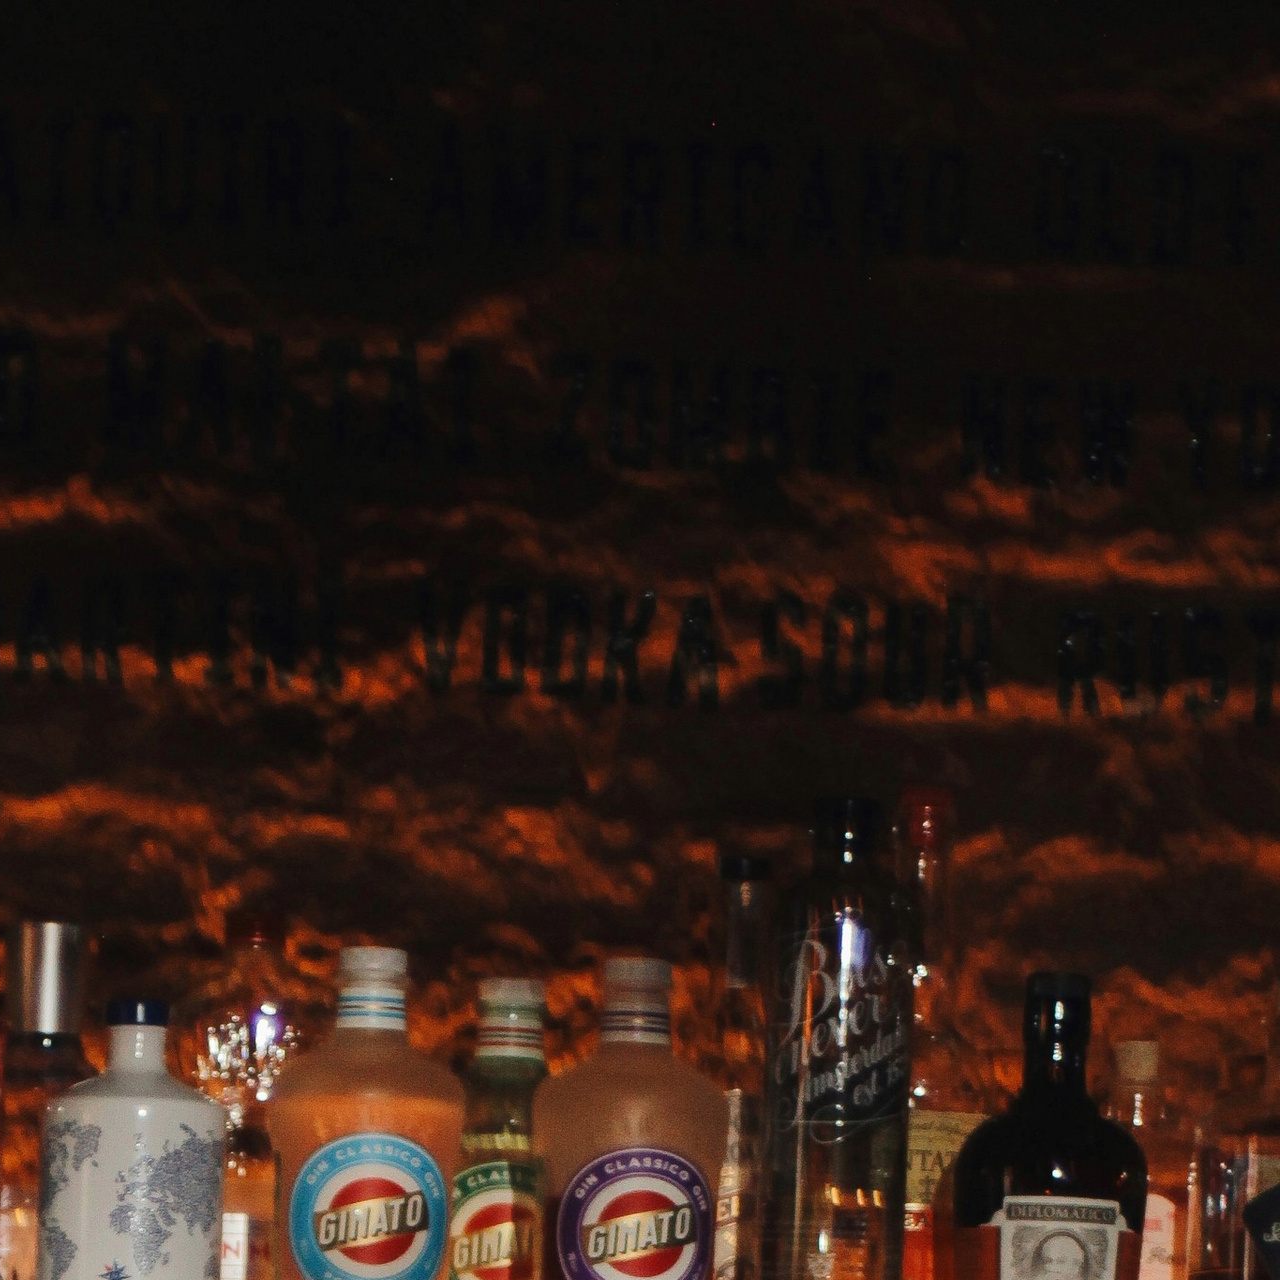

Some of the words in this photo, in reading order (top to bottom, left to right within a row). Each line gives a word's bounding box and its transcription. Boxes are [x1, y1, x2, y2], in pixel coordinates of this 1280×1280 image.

[424, 124, 968, 260] AMERICANO
[758, 592, 990, 713] SOUR
[574, 1173, 599, 1199] GIN
[603, 1156, 690, 1181] CLASSICO
[319, 1194, 423, 1248] GINATO
[587, 1206, 692, 1259] GINATO
